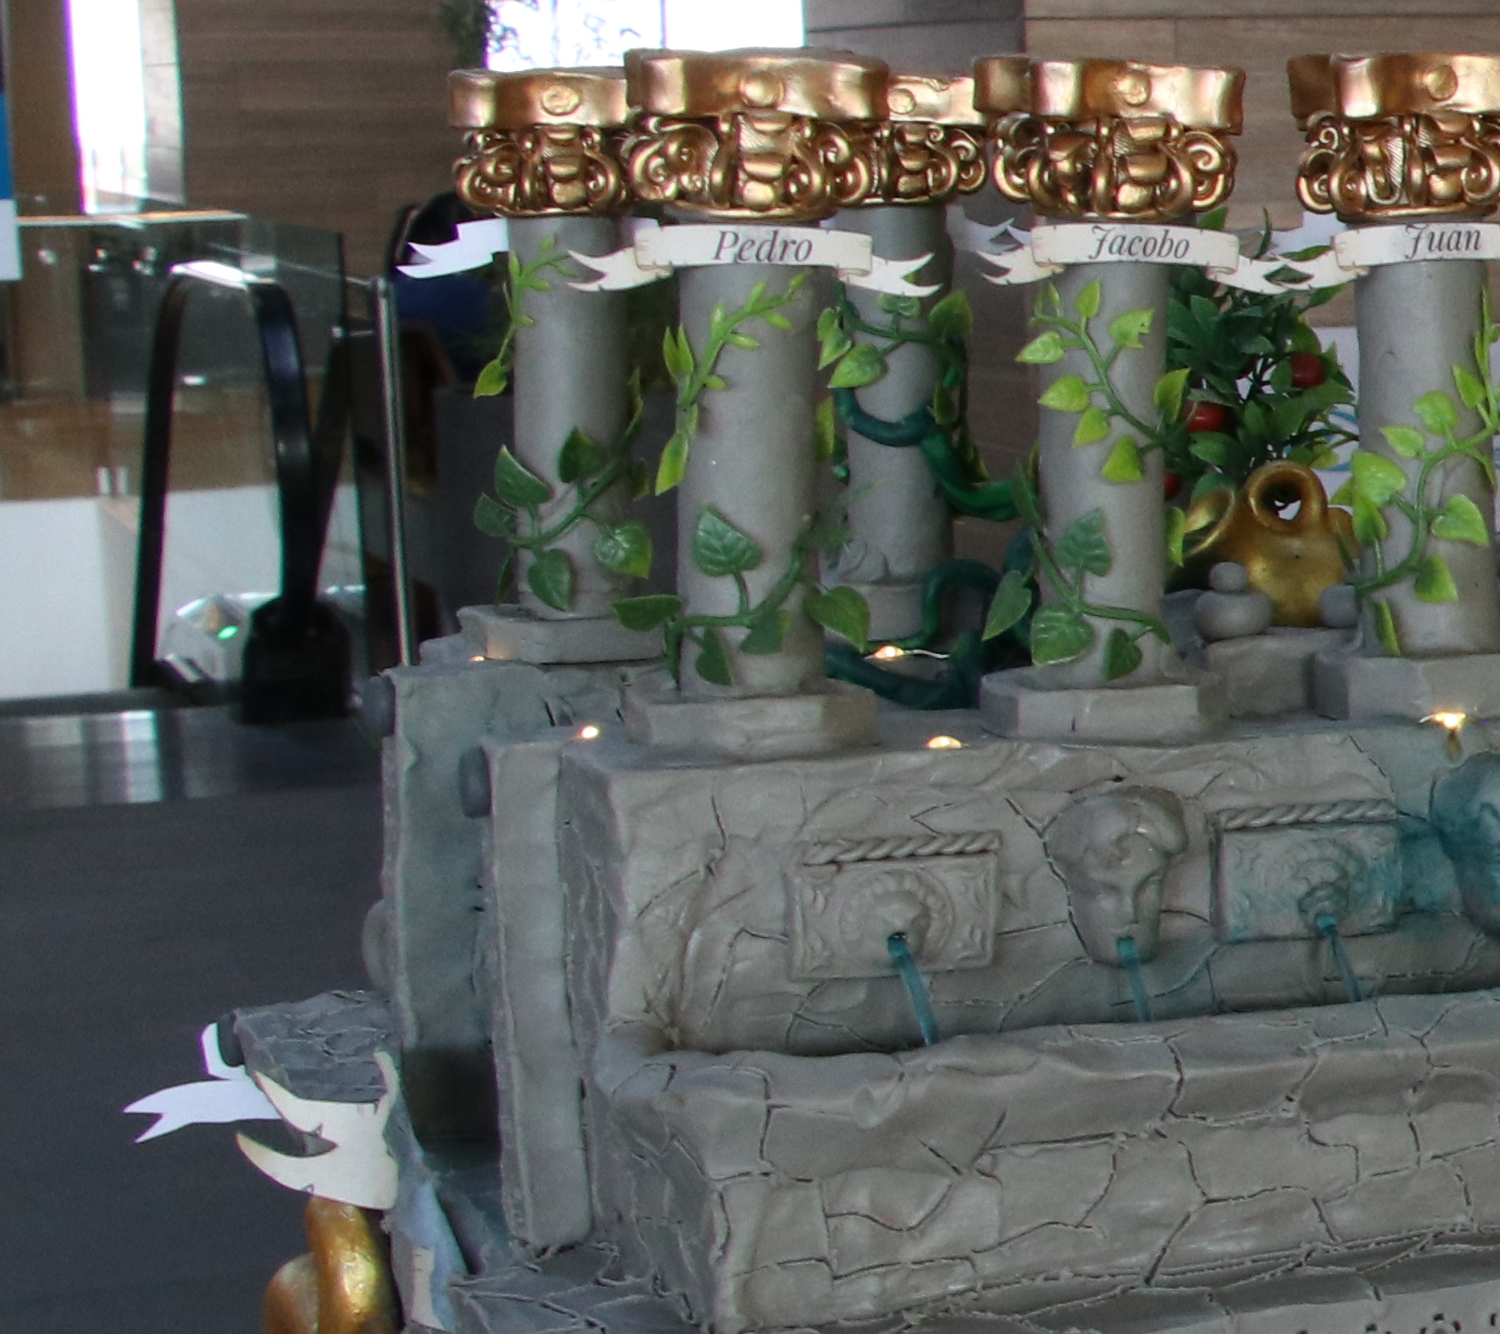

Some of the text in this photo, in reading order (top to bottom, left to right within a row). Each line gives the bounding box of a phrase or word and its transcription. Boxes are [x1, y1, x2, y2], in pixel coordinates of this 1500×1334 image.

[713, 229, 813, 264] Pedro
[1090, 224, 1190, 261] Jacobo
[1405, 224, 1482, 259] Juan
